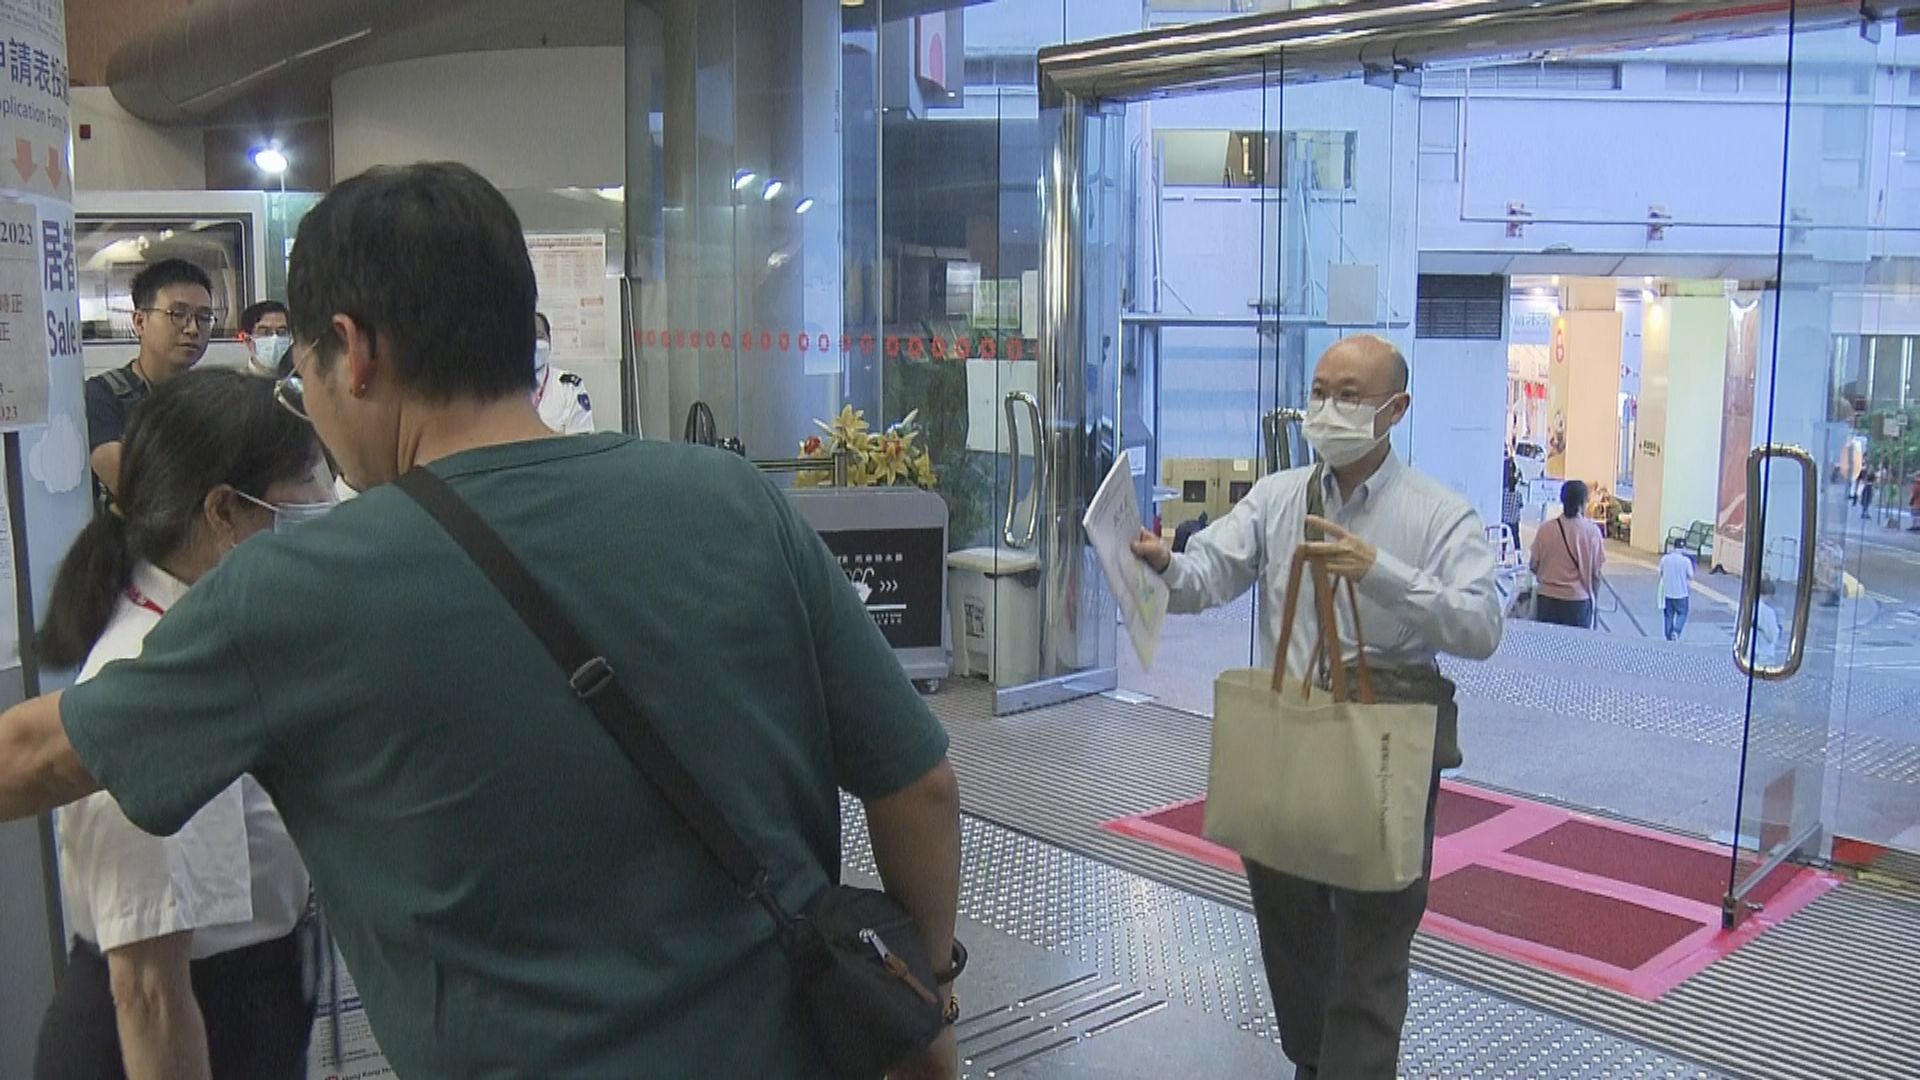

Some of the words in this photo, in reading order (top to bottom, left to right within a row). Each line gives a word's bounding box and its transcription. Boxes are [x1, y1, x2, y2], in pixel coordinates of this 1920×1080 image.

[0, 96, 46, 122] plication
[0, 221, 33, 246] 2023
[46, 307, 77, 357] Sale
